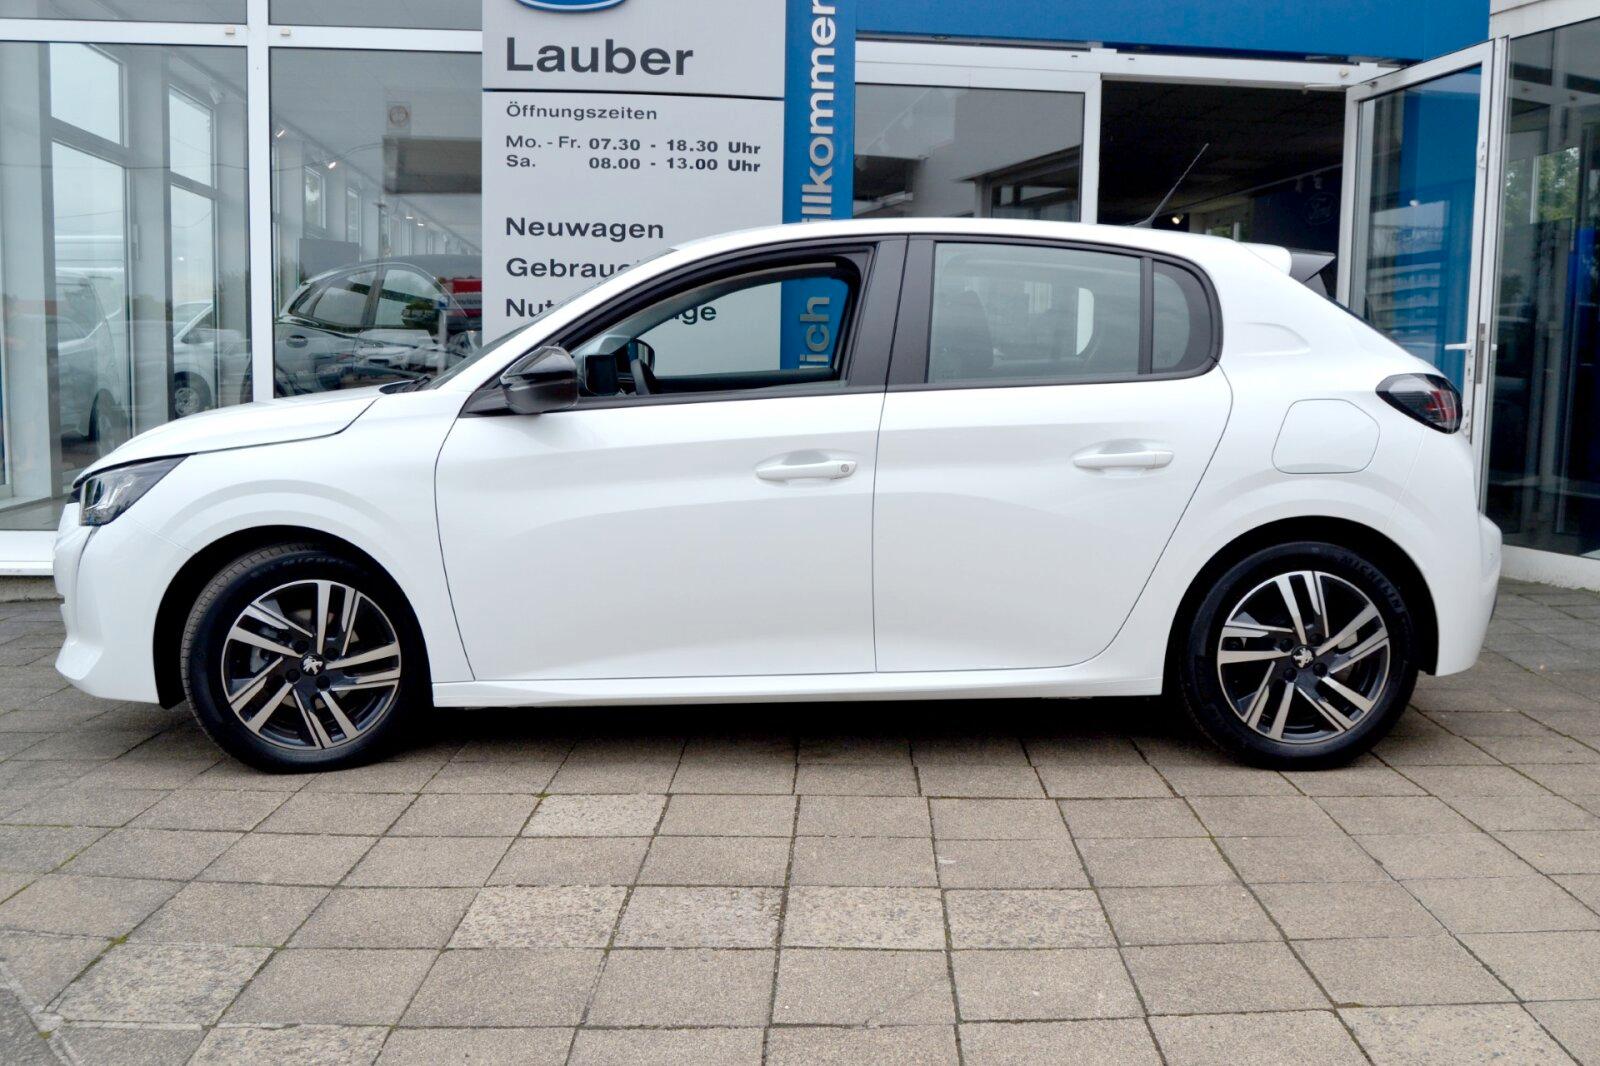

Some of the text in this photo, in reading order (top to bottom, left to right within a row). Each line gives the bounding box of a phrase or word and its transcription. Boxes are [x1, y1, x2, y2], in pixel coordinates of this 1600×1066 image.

[506, 36, 694, 76] Lauber
[506, 101, 657, 122] Öffnungszeiten
[505, 134, 542, 149] Mo.
[558, 135, 581, 149] Fr.
[588, 137, 641, 151] 07.30
[666, 139, 719, 153] 18.30
[727, 141, 761, 155] Uhr
[506, 154, 536, 168] Sa.
[588, 156, 641, 170] 08.00
[666, 157, 719, 171] 13.00
[727, 158, 761, 173] Uhr
[505, 216, 664, 243] Neuwagen
[505, 257, 640, 280] Gebrau
[674, 305, 717, 326] ge
